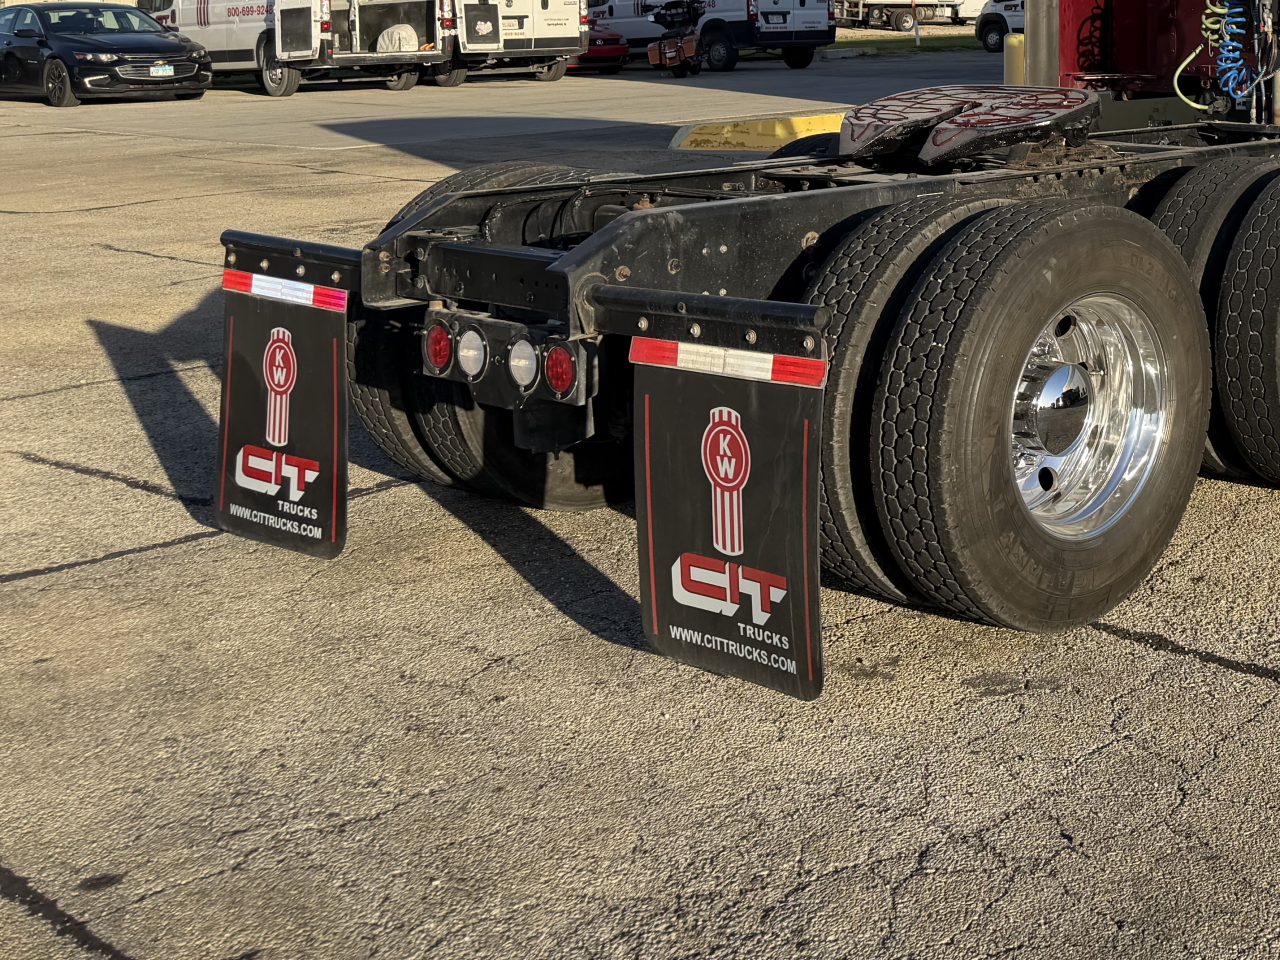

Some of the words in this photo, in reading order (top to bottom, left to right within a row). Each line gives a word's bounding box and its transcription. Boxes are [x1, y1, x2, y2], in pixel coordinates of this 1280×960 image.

[236, 444, 320, 501] CIT
[229, 503, 323, 540] WWW.CITTRUCKS.COM
[277, 499, 319, 520] TRUCKS
[671, 551, 788, 626] CIT
[669, 624, 797, 675] WWW.CITTRUCKS.COM
[737, 622, 790, 650] TRUCKS
